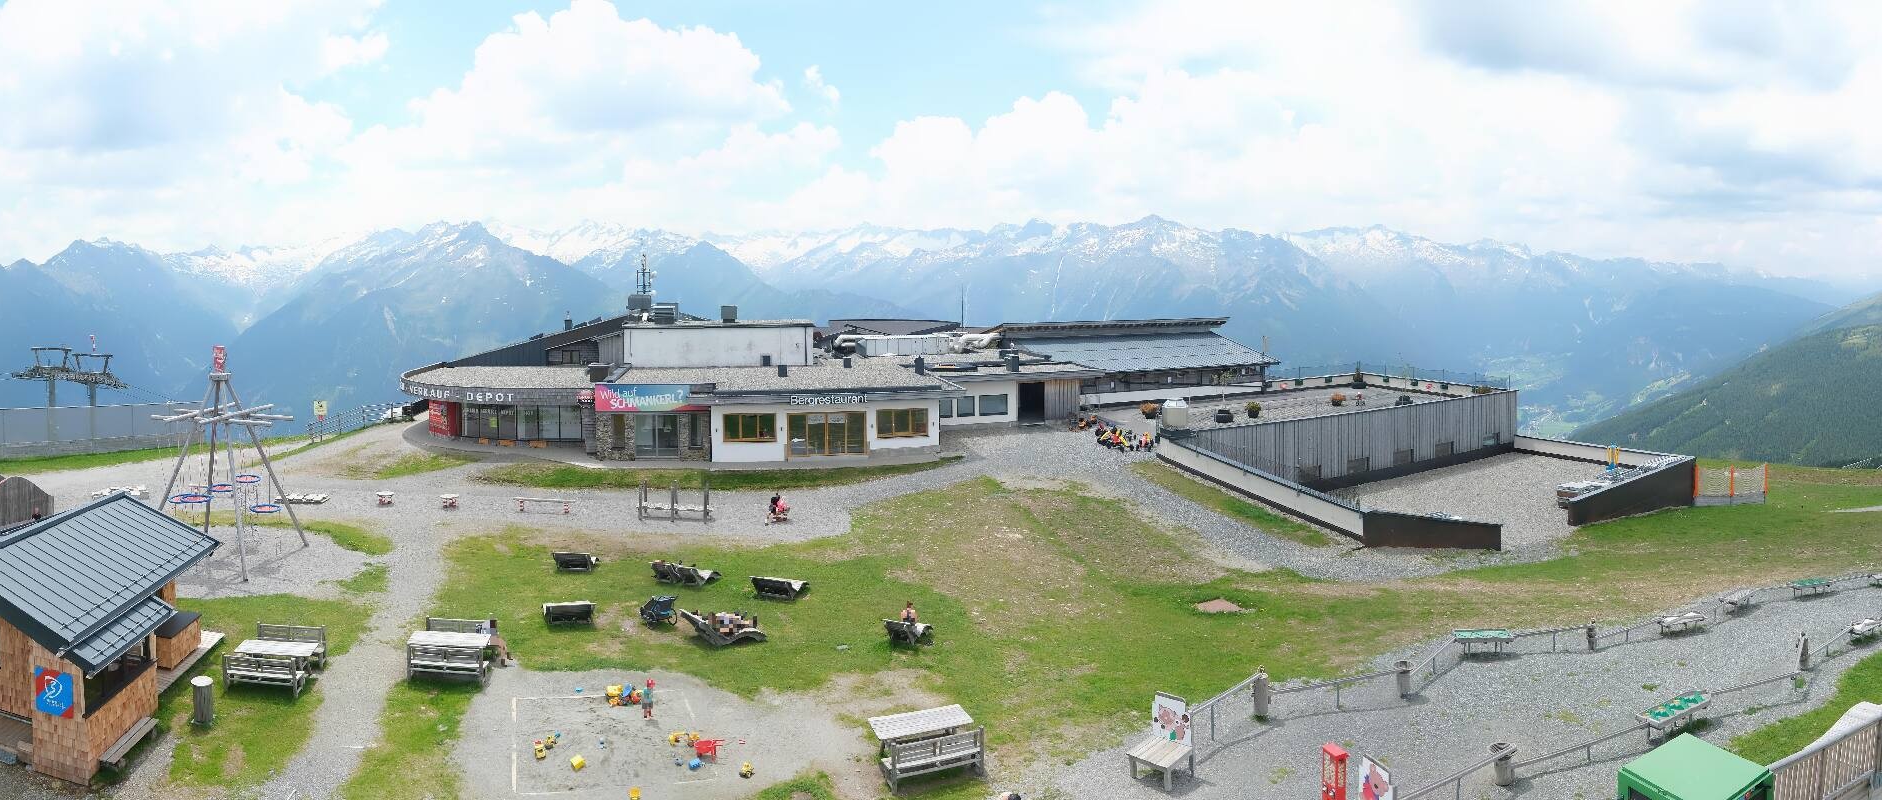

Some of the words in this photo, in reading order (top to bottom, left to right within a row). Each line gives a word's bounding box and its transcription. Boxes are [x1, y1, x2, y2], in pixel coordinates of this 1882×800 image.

[409, 385, 450, 398] VERKAUF
[466, 391, 515, 402] DEPOT
[600, 389, 621, 400] Wild
[622, 387, 637, 398] auf
[609, 390, 684, 409] SCHMANKERL?
[790, 394, 868, 406] Bergrestaurant
